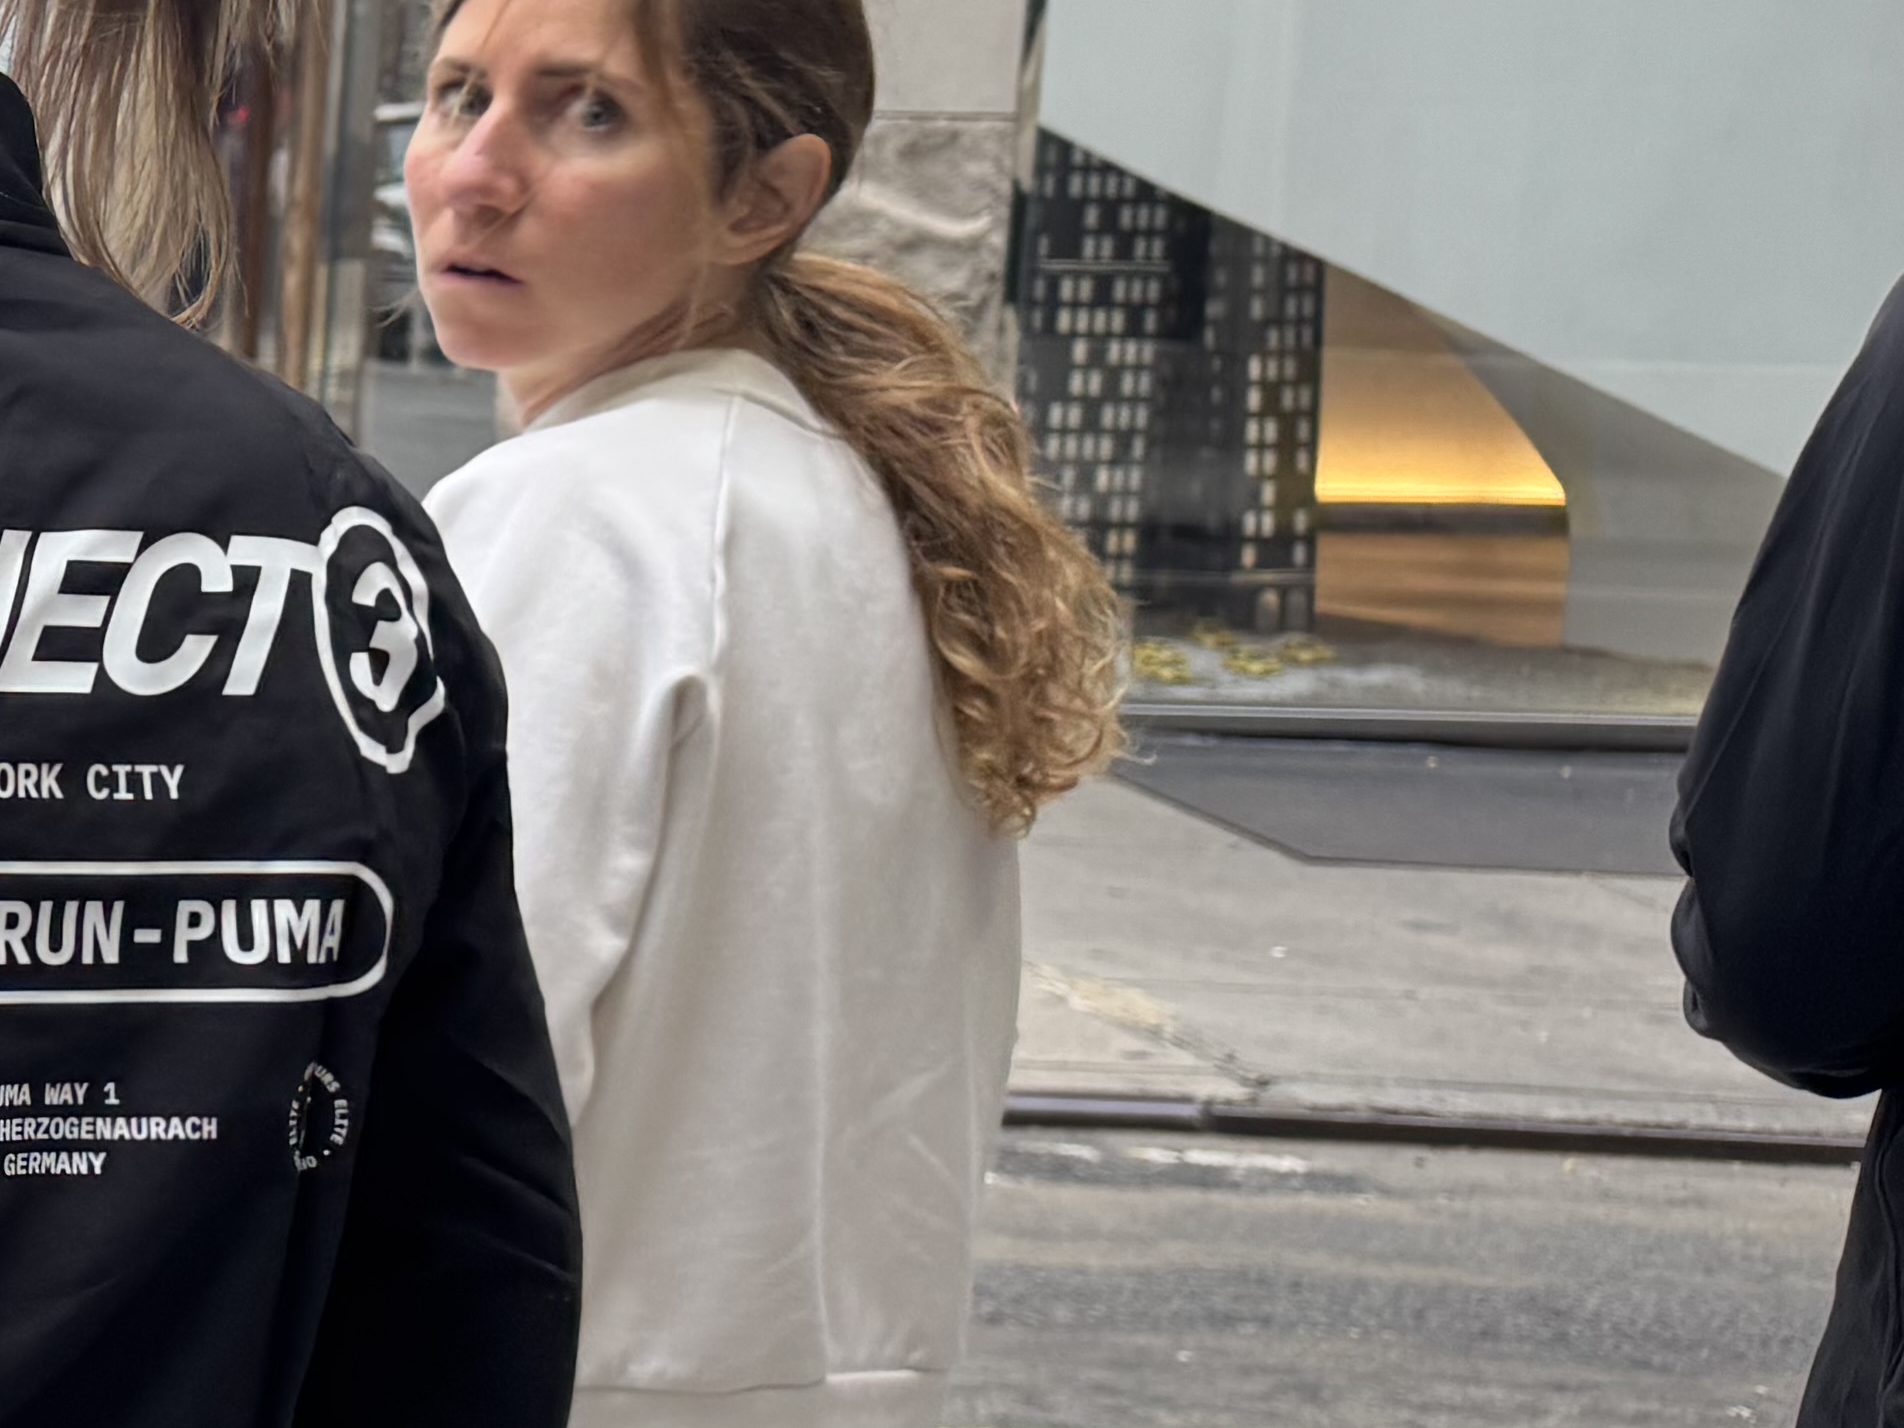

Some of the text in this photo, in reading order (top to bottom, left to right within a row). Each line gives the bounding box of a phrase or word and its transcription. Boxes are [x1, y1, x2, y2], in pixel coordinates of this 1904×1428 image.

[352, 560, 420, 711] 3
[86, 763, 184, 801] CITY
[44, 1082, 89, 1106] WAY
[103, 1081, 121, 1105] 1
[3, 1151, 107, 1176] GERMANY
